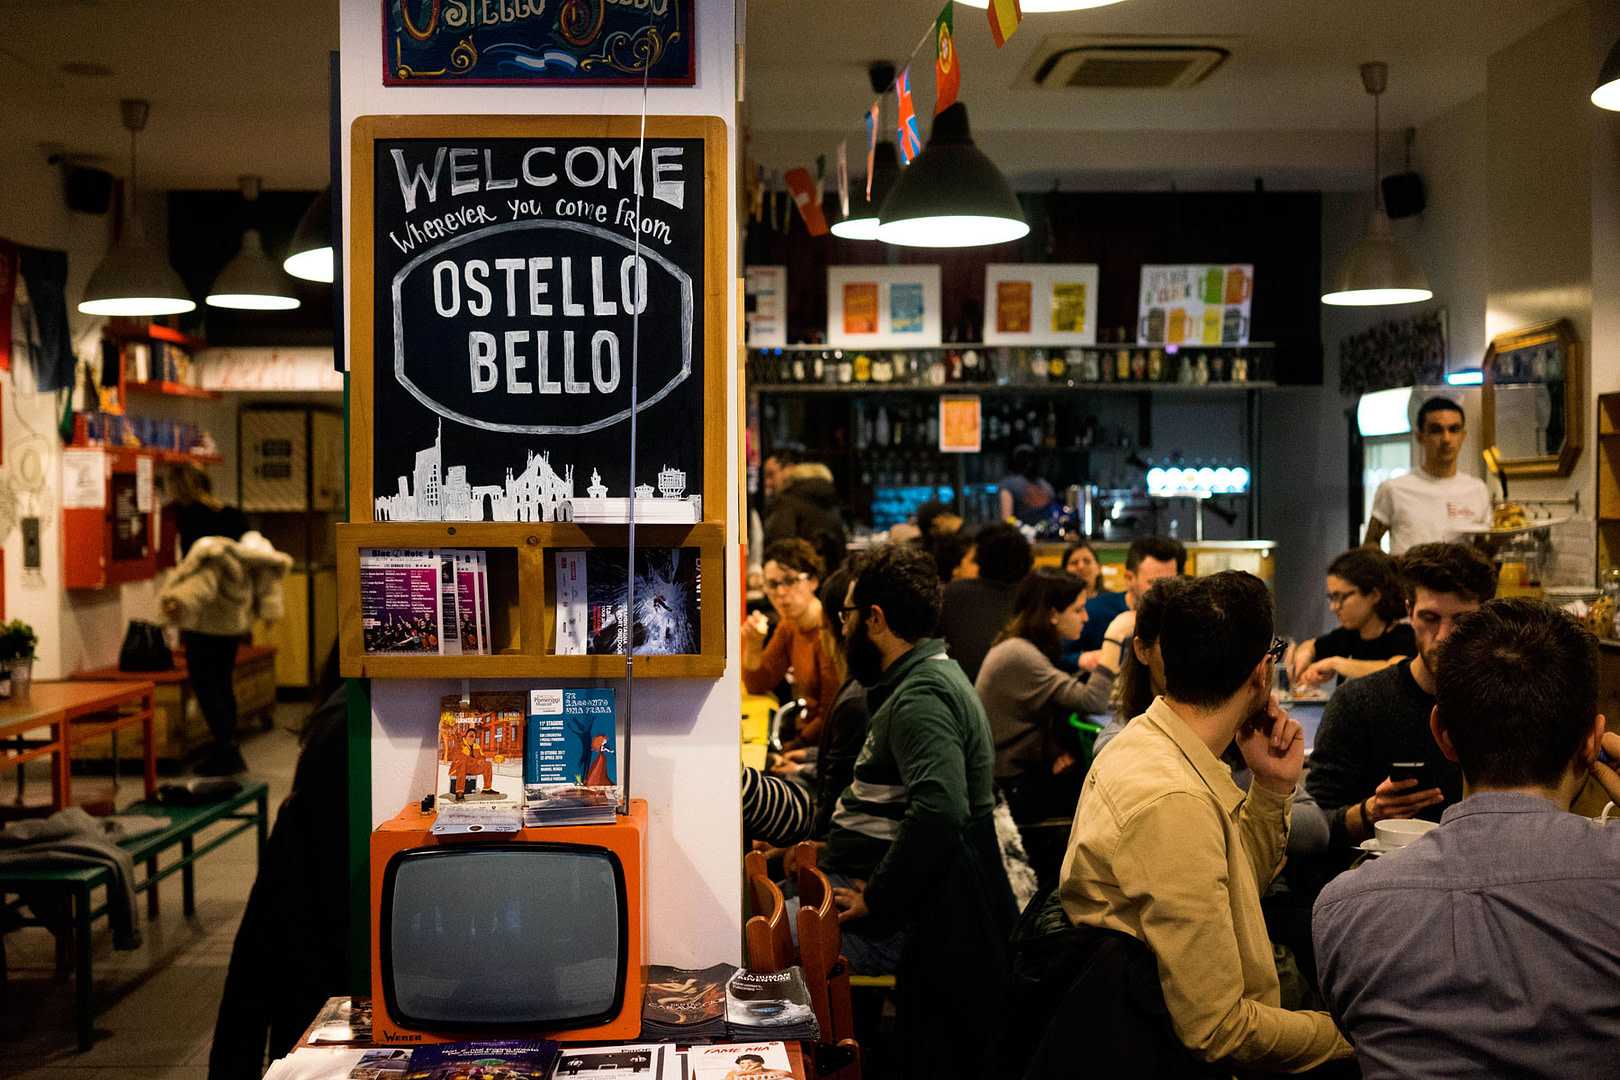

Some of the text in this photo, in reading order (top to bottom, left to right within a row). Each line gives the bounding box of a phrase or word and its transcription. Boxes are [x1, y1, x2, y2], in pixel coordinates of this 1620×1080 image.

[390, 146, 685, 212] WELCOME
[555, 198, 607, 222] come
[432, 254, 648, 318] OSTELLO
[468, 330, 620, 394] BELLO
[372, 549, 424, 557] Blue Note
